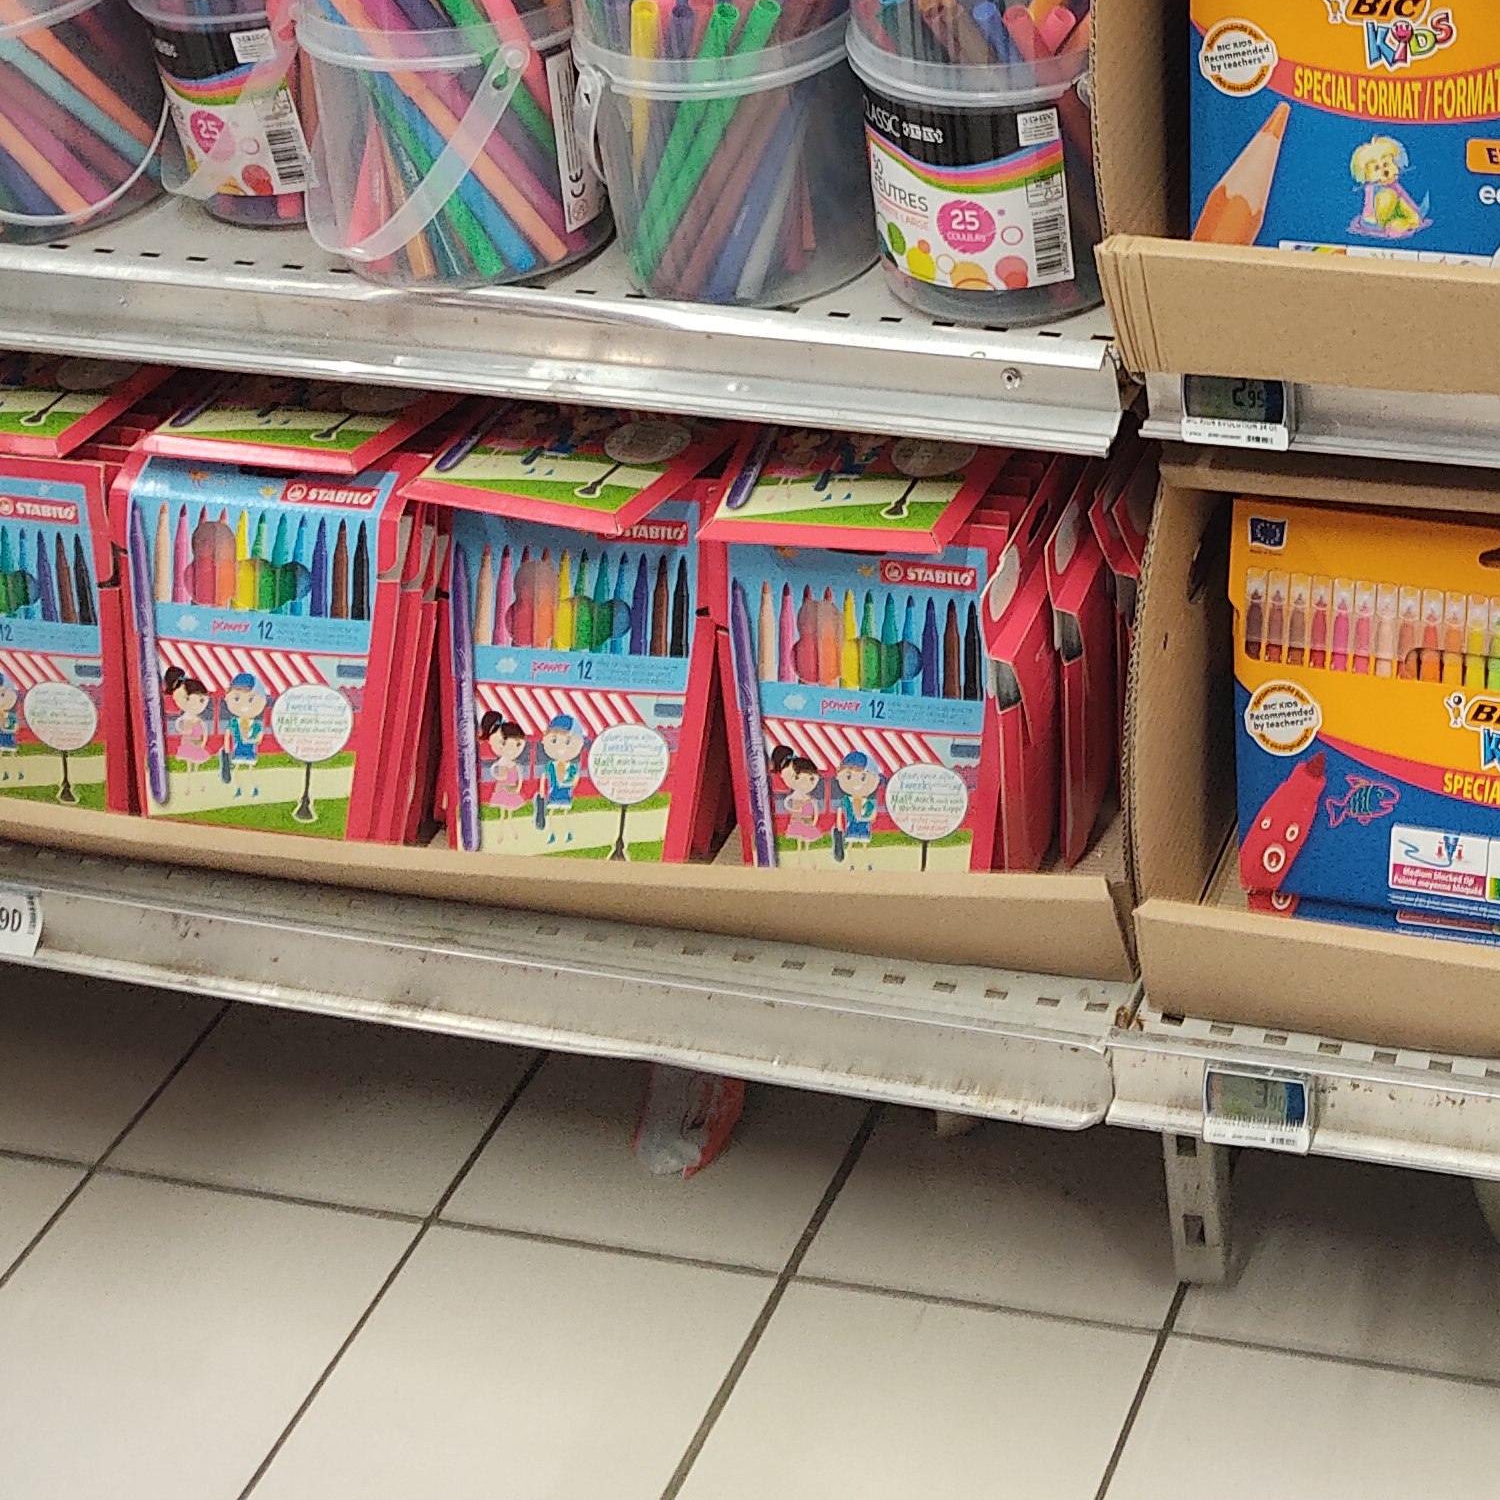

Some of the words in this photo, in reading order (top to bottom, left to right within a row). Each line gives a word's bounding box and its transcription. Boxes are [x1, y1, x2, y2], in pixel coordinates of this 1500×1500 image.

[1204, 44, 1270, 63] Recommended
[1210, 64, 1221, 72] by
[1294, 69, 1355, 111] SPECIAL
[1357, 80, 1421, 118] FORMAT
[197, 119, 220, 139] 25
[874, 172, 929, 212] FEUTRES
[950, 209, 980, 231] 25
[308, 486, 372, 505] STABILO
[15, 502, 76, 521] STABILO
[626, 523, 687, 542] STABILO
[906, 567, 973, 586] STABILO
[257, 620, 273, 641] 12
[577, 660, 592, 680] 12
[821, 699, 861, 715] power
[869, 700, 885, 719] 12
[1250, 708, 1314, 721] Recommended
[1254, 722, 1264, 731] by
[1392, 876, 1417, 887] Pointe
[1418, 879, 1450, 893] moyenne
[1402, 867, 1432, 880] Medium
[1434, 870, 1464, 884] blocked
[1465, 875, 1475, 886] tip
